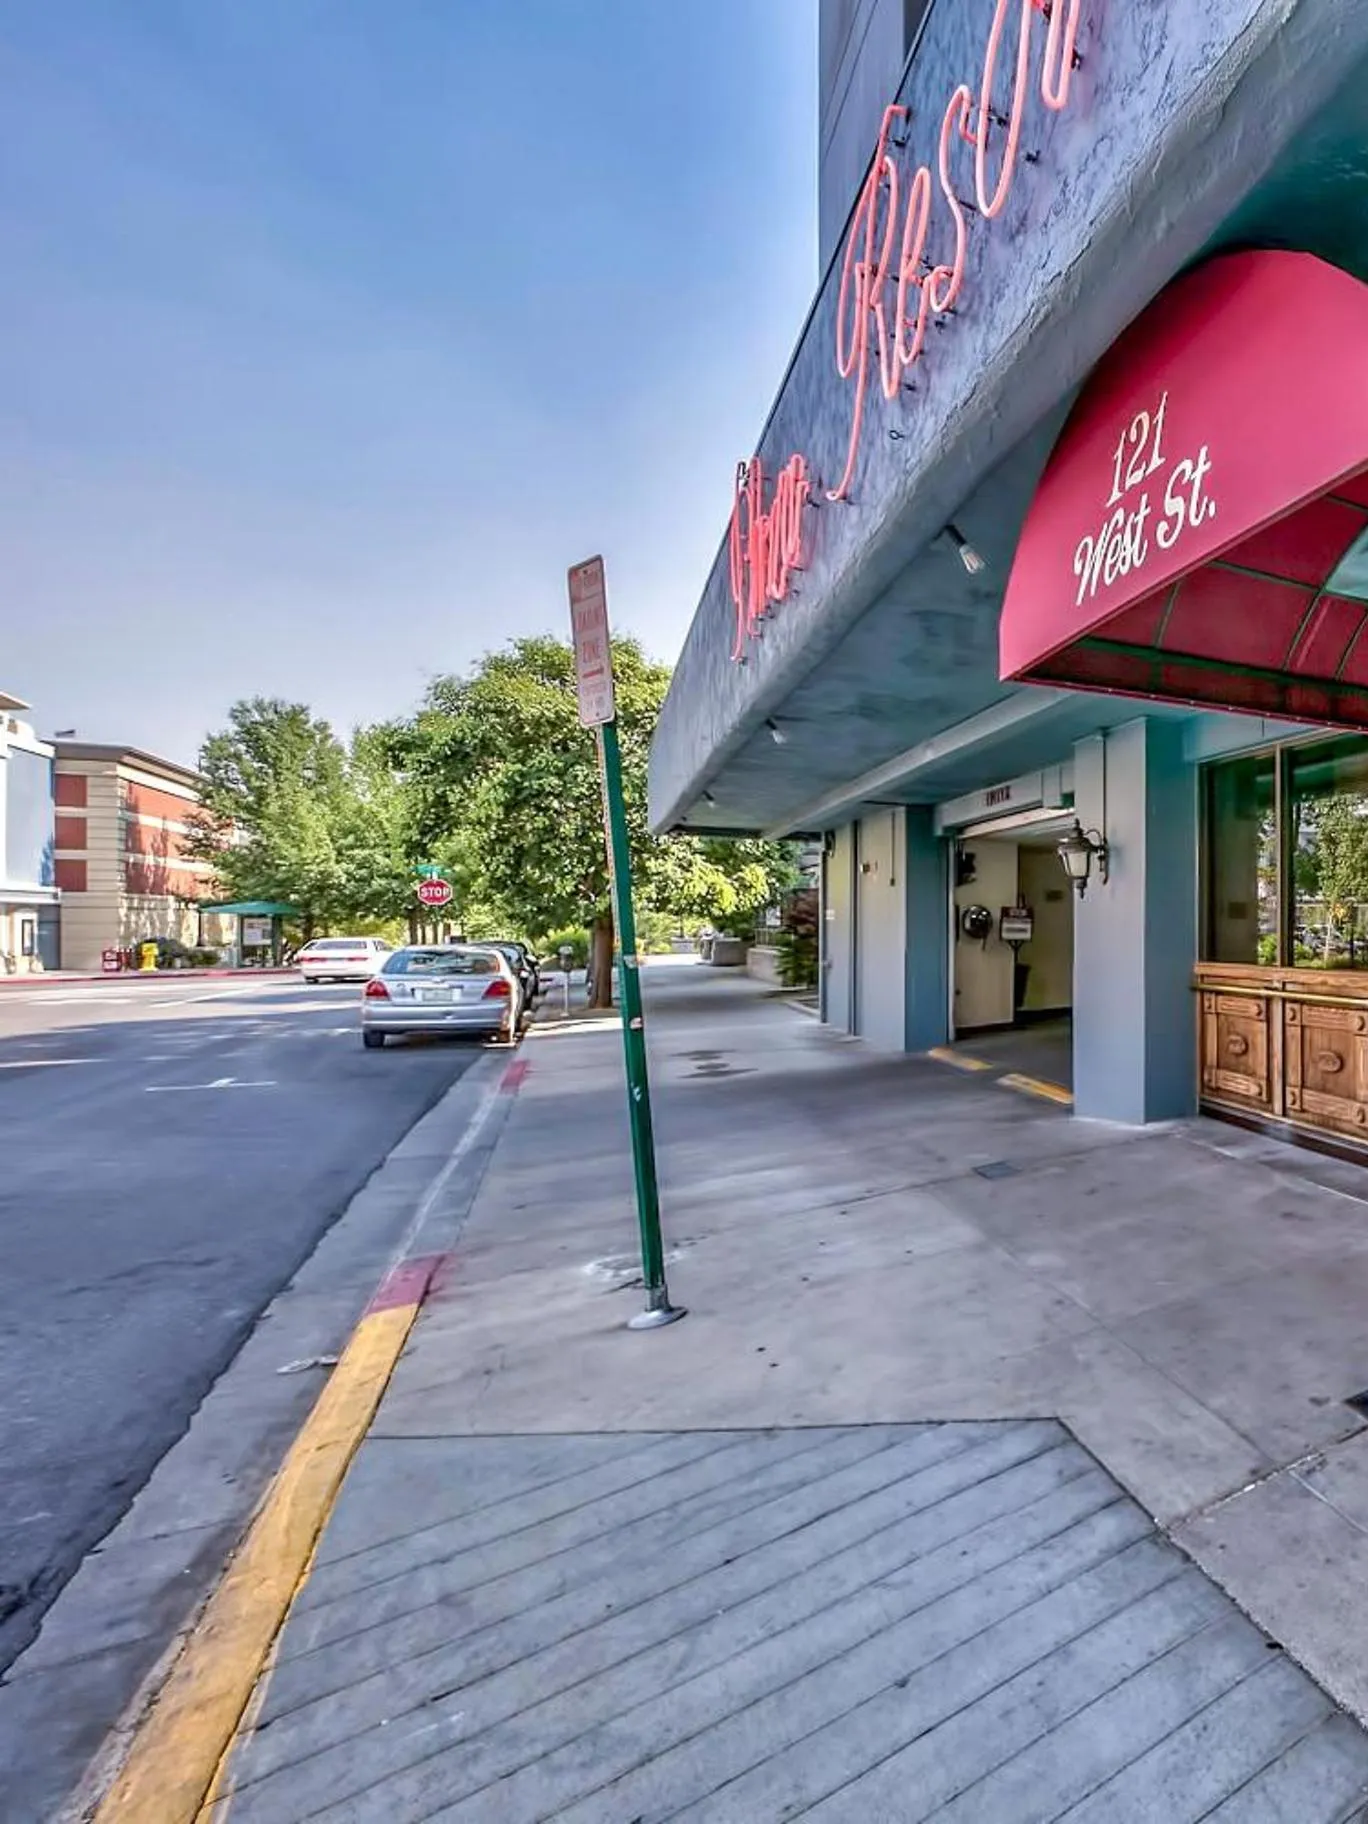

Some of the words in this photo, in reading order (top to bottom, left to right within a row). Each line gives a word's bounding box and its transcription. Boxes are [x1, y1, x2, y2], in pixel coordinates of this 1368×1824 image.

[1105, 390, 1168, 507] 121
[1073, 493, 1151, 606] West
[1156, 445, 1216, 549] St.
[420, 886, 450, 898] STOP
